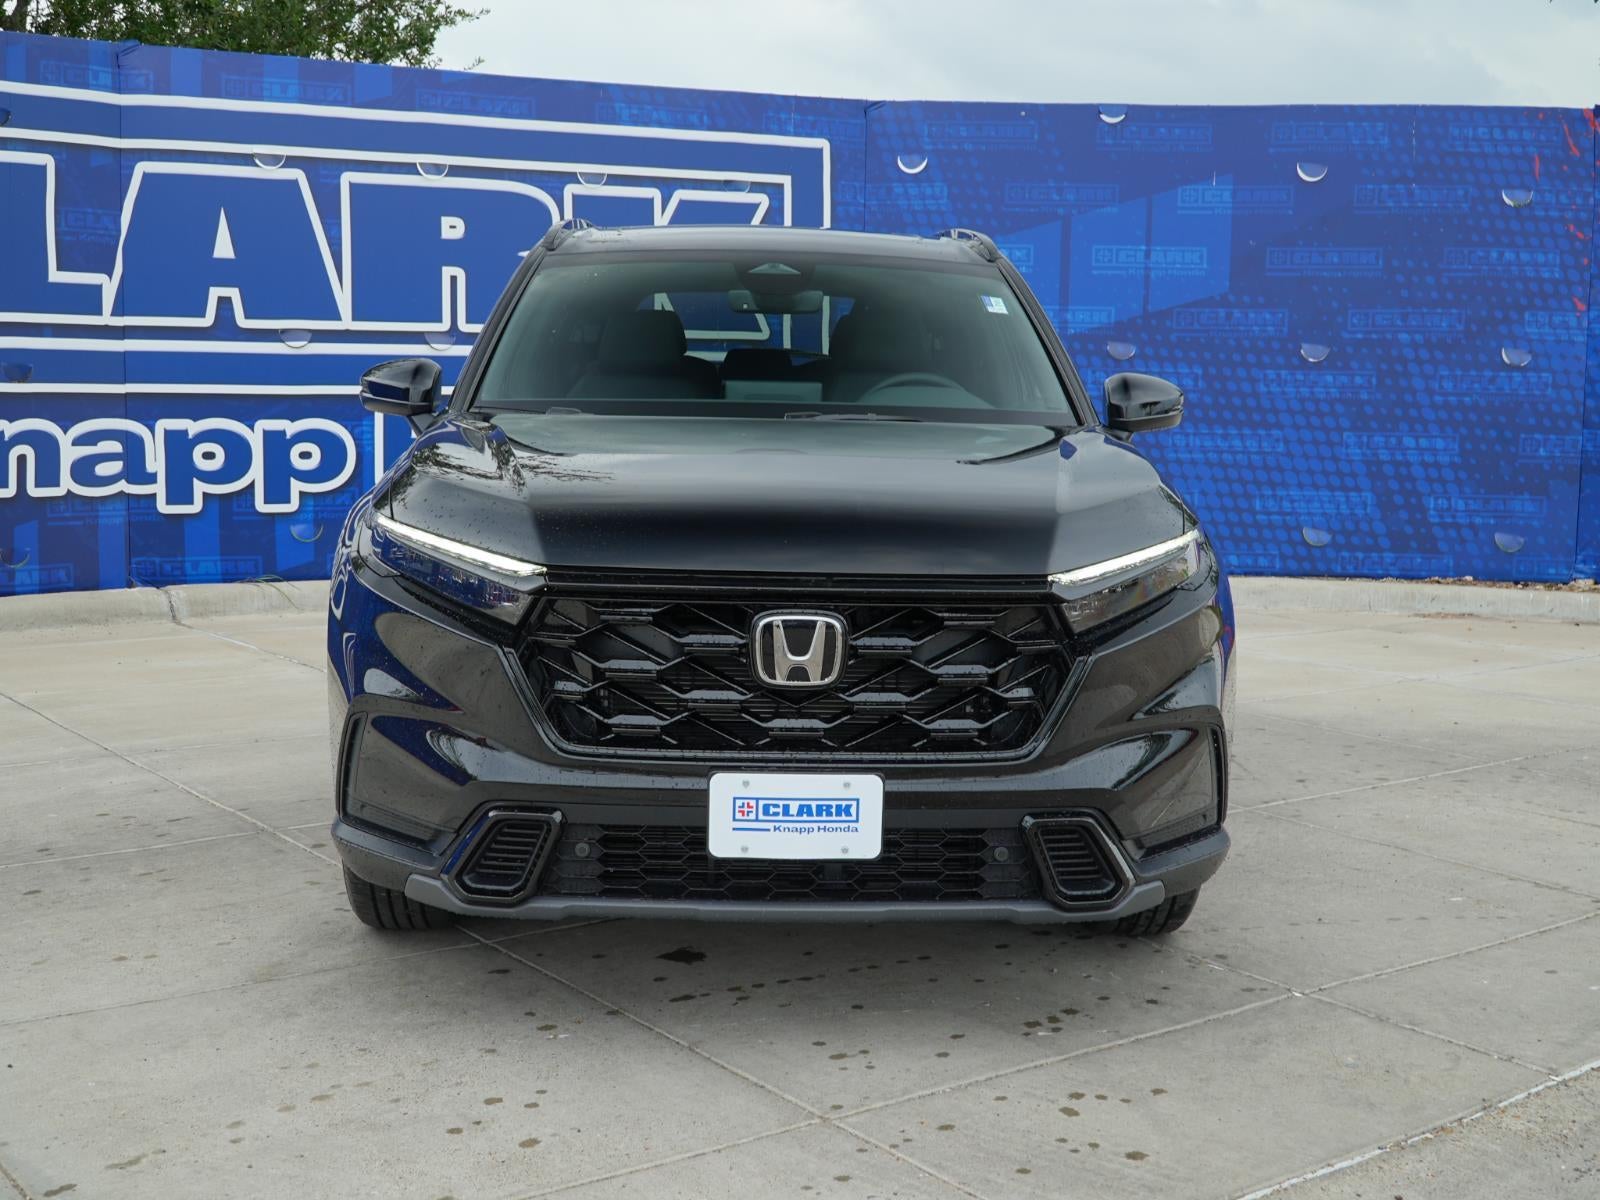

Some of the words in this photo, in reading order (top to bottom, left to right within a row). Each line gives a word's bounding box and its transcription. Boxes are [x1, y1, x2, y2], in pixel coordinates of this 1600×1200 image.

[0, 151, 770, 340] LAR
[0, 418, 356, 514] napp
[762, 803, 853, 817] CLARK
[773, 824, 815, 835] Knapp
[817, 825, 859, 833] Honda
